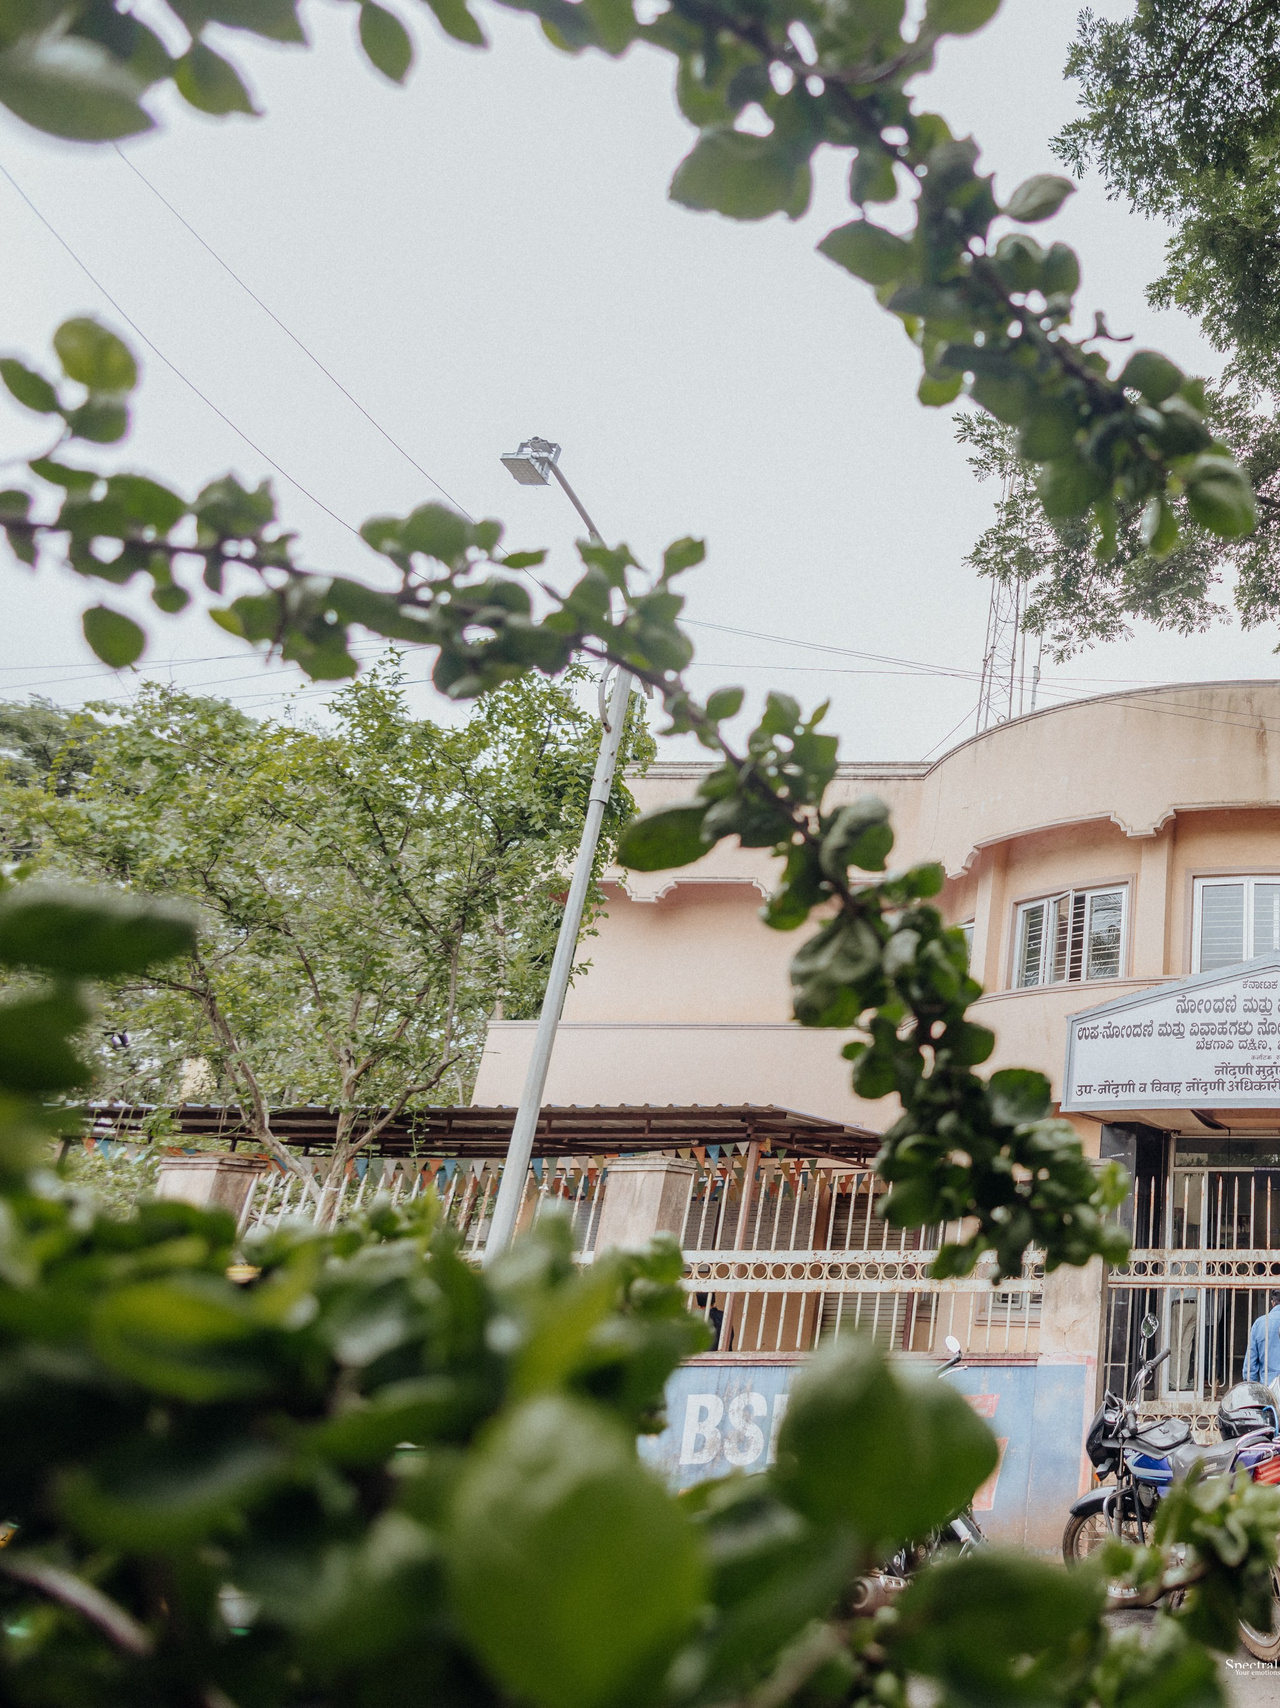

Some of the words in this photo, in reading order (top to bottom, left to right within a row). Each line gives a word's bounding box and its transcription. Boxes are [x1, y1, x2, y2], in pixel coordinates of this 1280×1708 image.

[1242, 980, 1278, 990] ಕರ್ನಾಟಕ
[1242, 996, 1273, 1016] ಮತ್ತು
[1157, 1020, 1186, 1040] ಮತ್ತು
[1189, 1019, 1253, 1037] ವಿವಾಹಗಳು
[1195, 1037, 1234, 1051] ಬೆಳಗಾವಿ
[1214, 1061, 1254, 1079] नोंदणी
[1138, 1082, 1147, 1094] व
[1150, 1079, 1183, 1097] विवाह
[1185, 1078, 1226, 1096] नोंदणी
